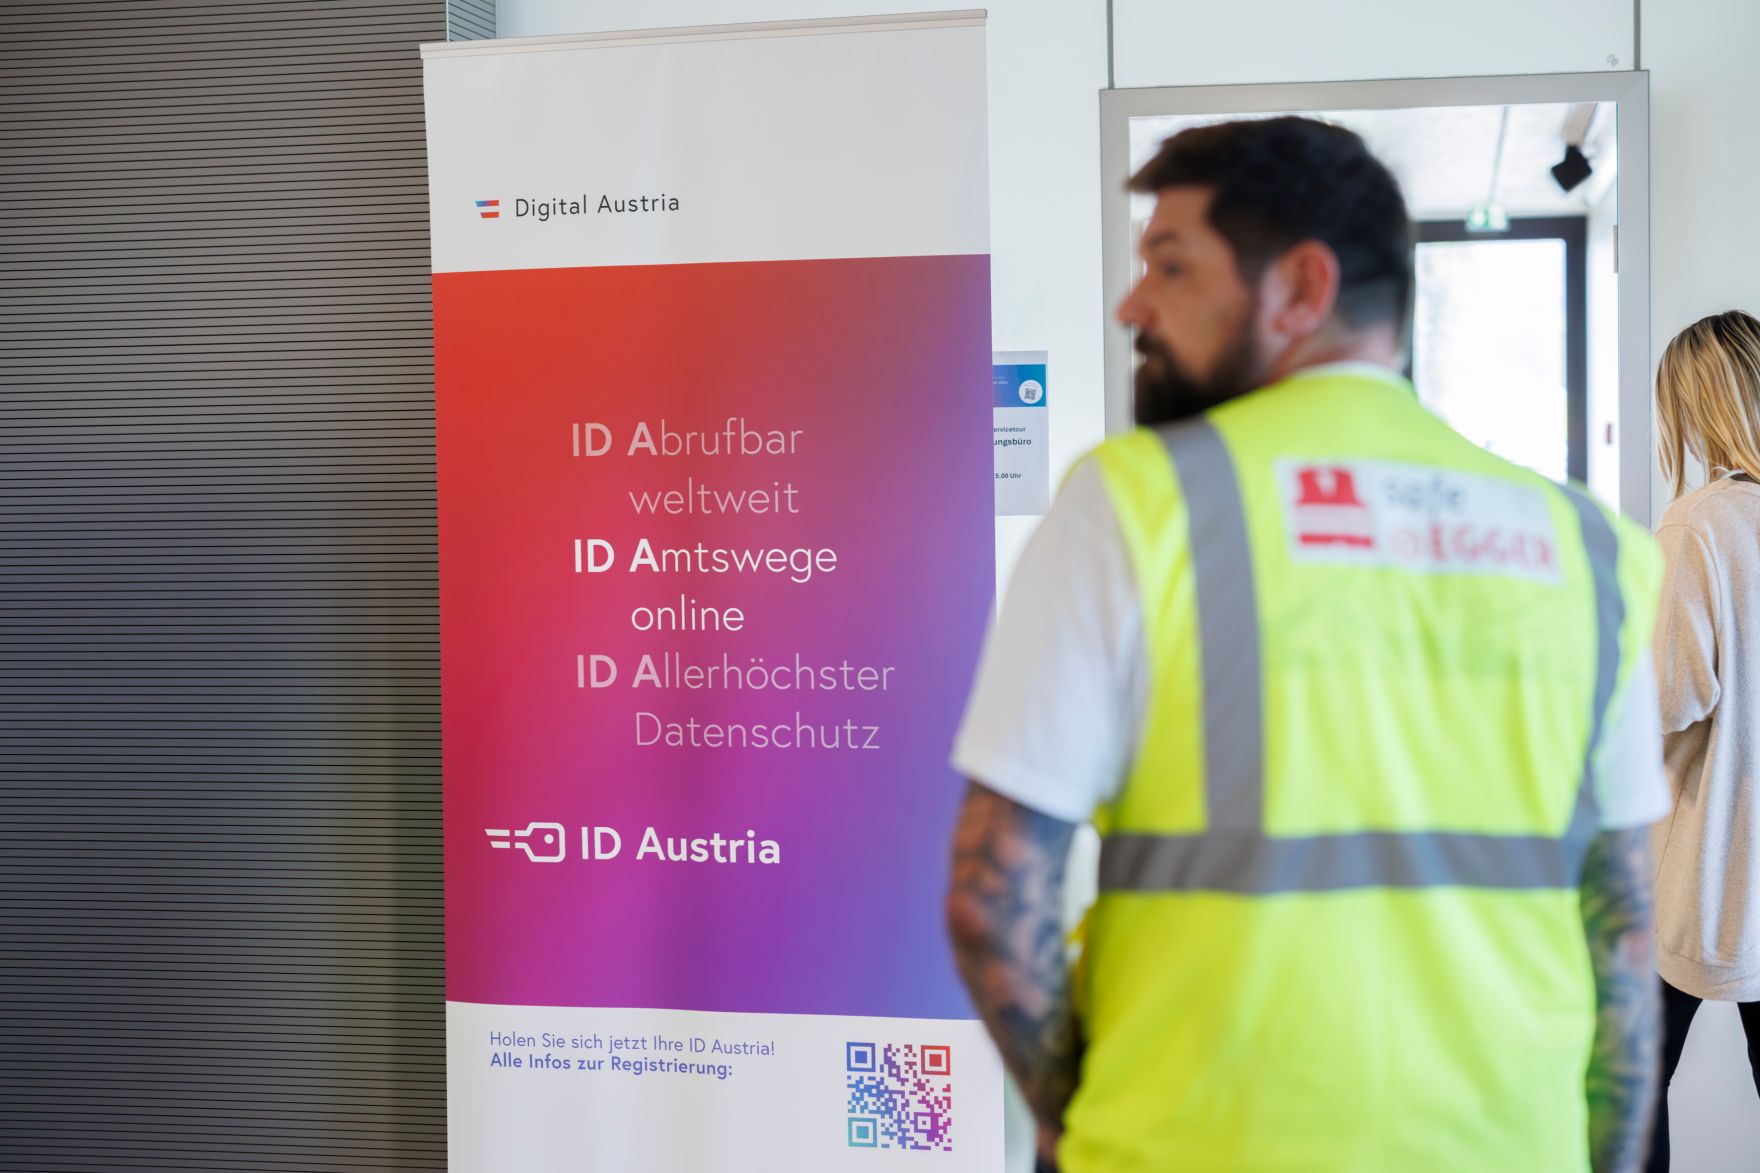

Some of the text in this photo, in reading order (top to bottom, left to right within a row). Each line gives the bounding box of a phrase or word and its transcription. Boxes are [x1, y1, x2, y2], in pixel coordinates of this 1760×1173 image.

[516, 193, 680, 222] Digital Austria
[572, 417, 804, 457] ID Abrufbar
[993, 437, 1032, 447] ungsbüro
[628, 477, 800, 514] weltweit
[574, 538, 838, 583] ID Amtswege
[631, 594, 745, 631] online
[576, 651, 896, 690] ID Allerhöchster
[636, 711, 880, 749] Datenschutz
[581, 826, 781, 864] ID Austria
[490, 1031, 775, 1056] Holen Sie sich jetzt Ihre ID Austria!
[490, 1052, 733, 1080] Alle Infos zur Registrierung:
